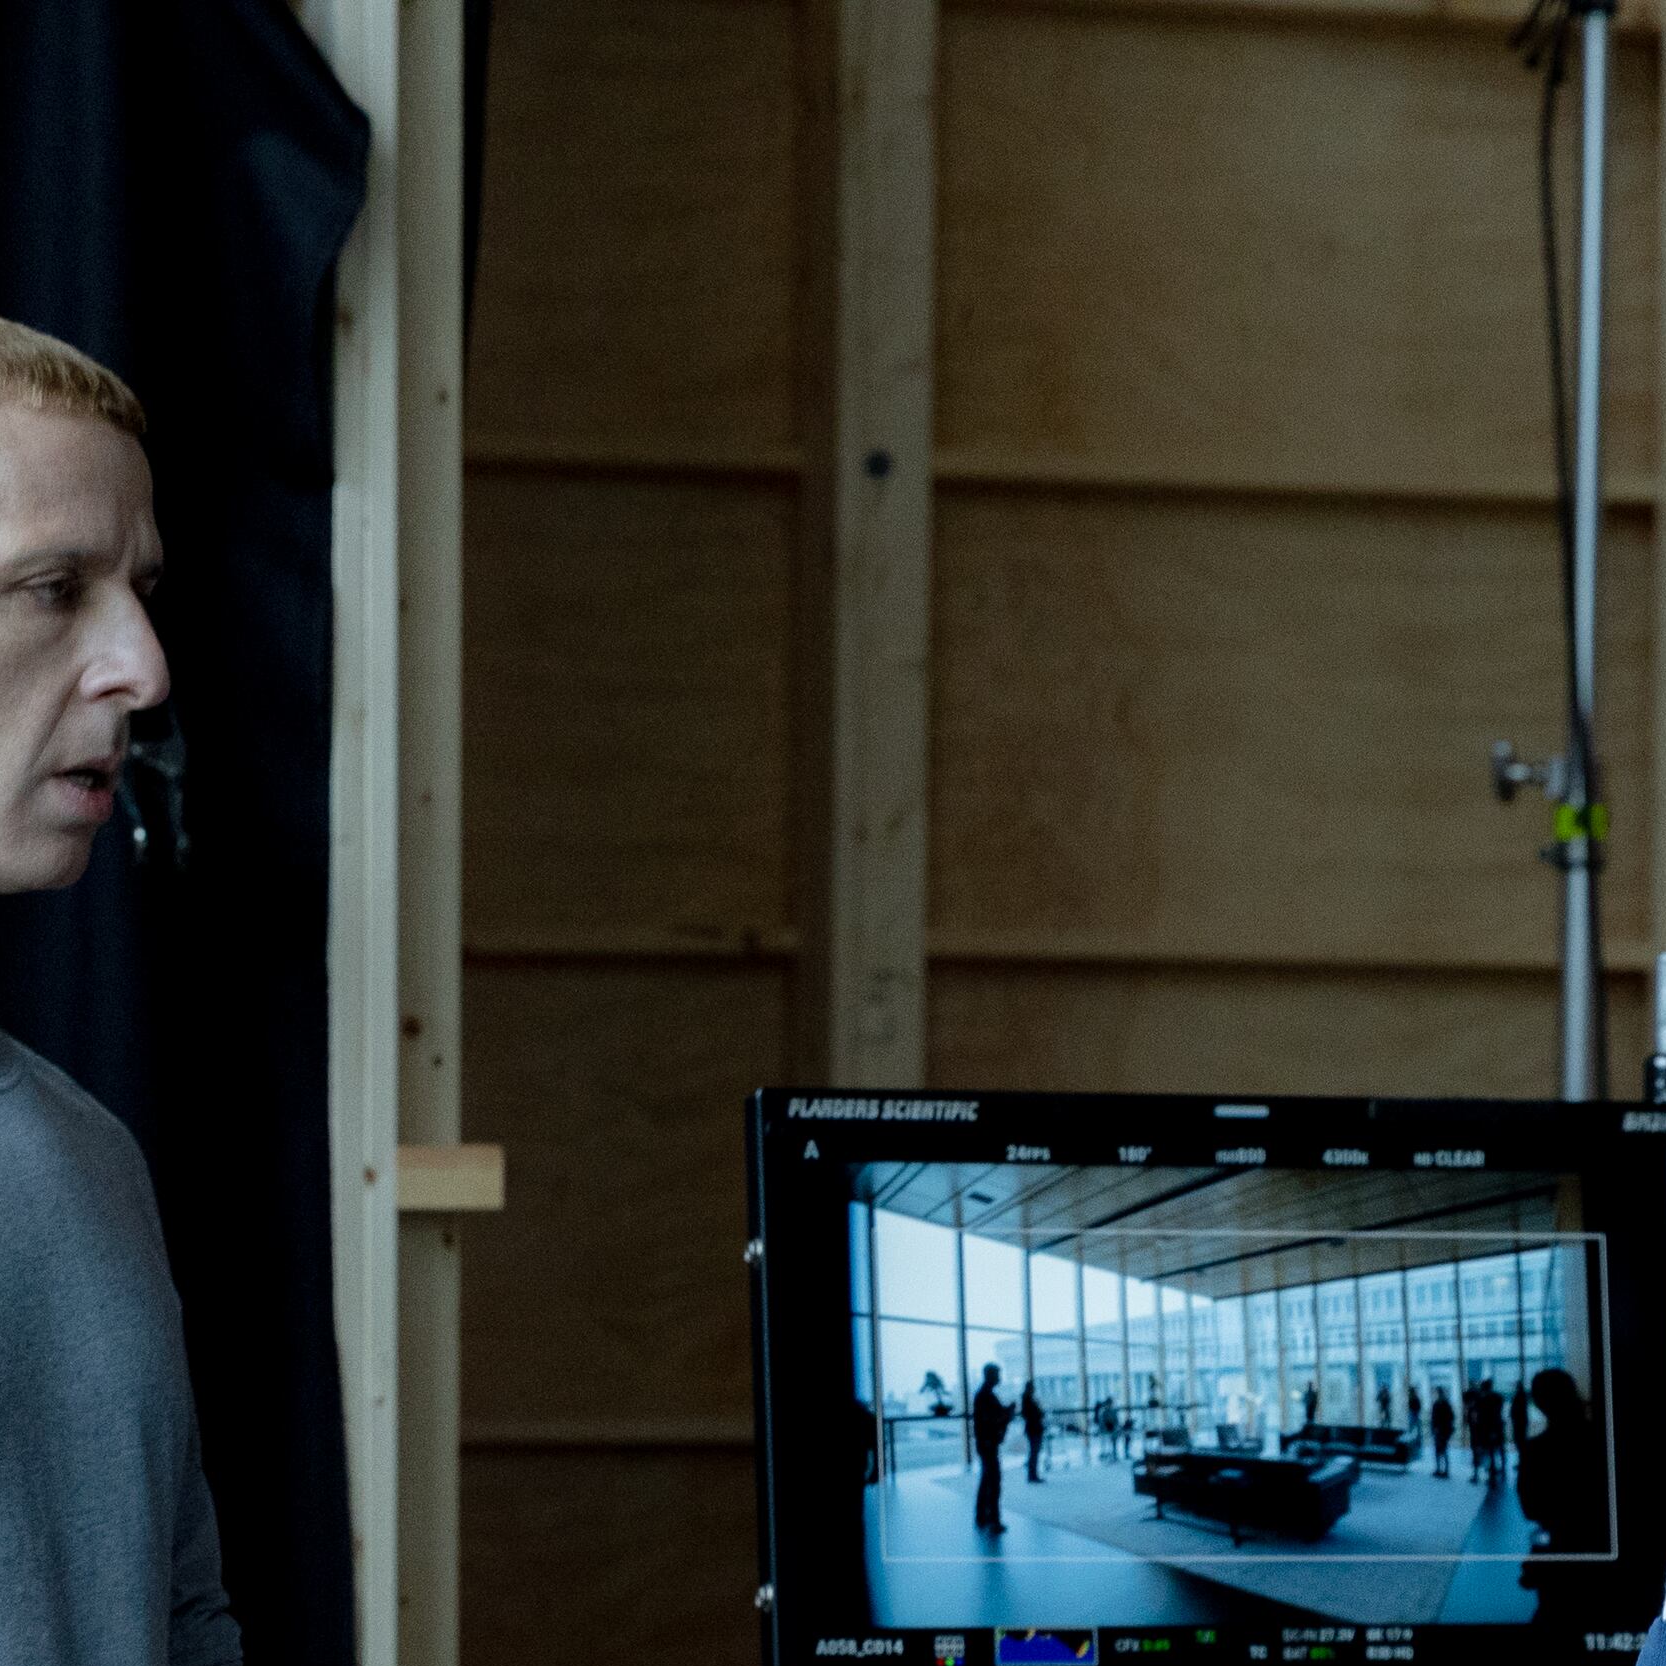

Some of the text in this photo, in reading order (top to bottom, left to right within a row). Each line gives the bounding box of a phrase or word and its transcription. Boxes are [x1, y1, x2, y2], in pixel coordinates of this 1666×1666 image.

[788, 1097, 979, 1122] FLANDERS SCIENTIFIC
[804, 1139, 820, 1160] A
